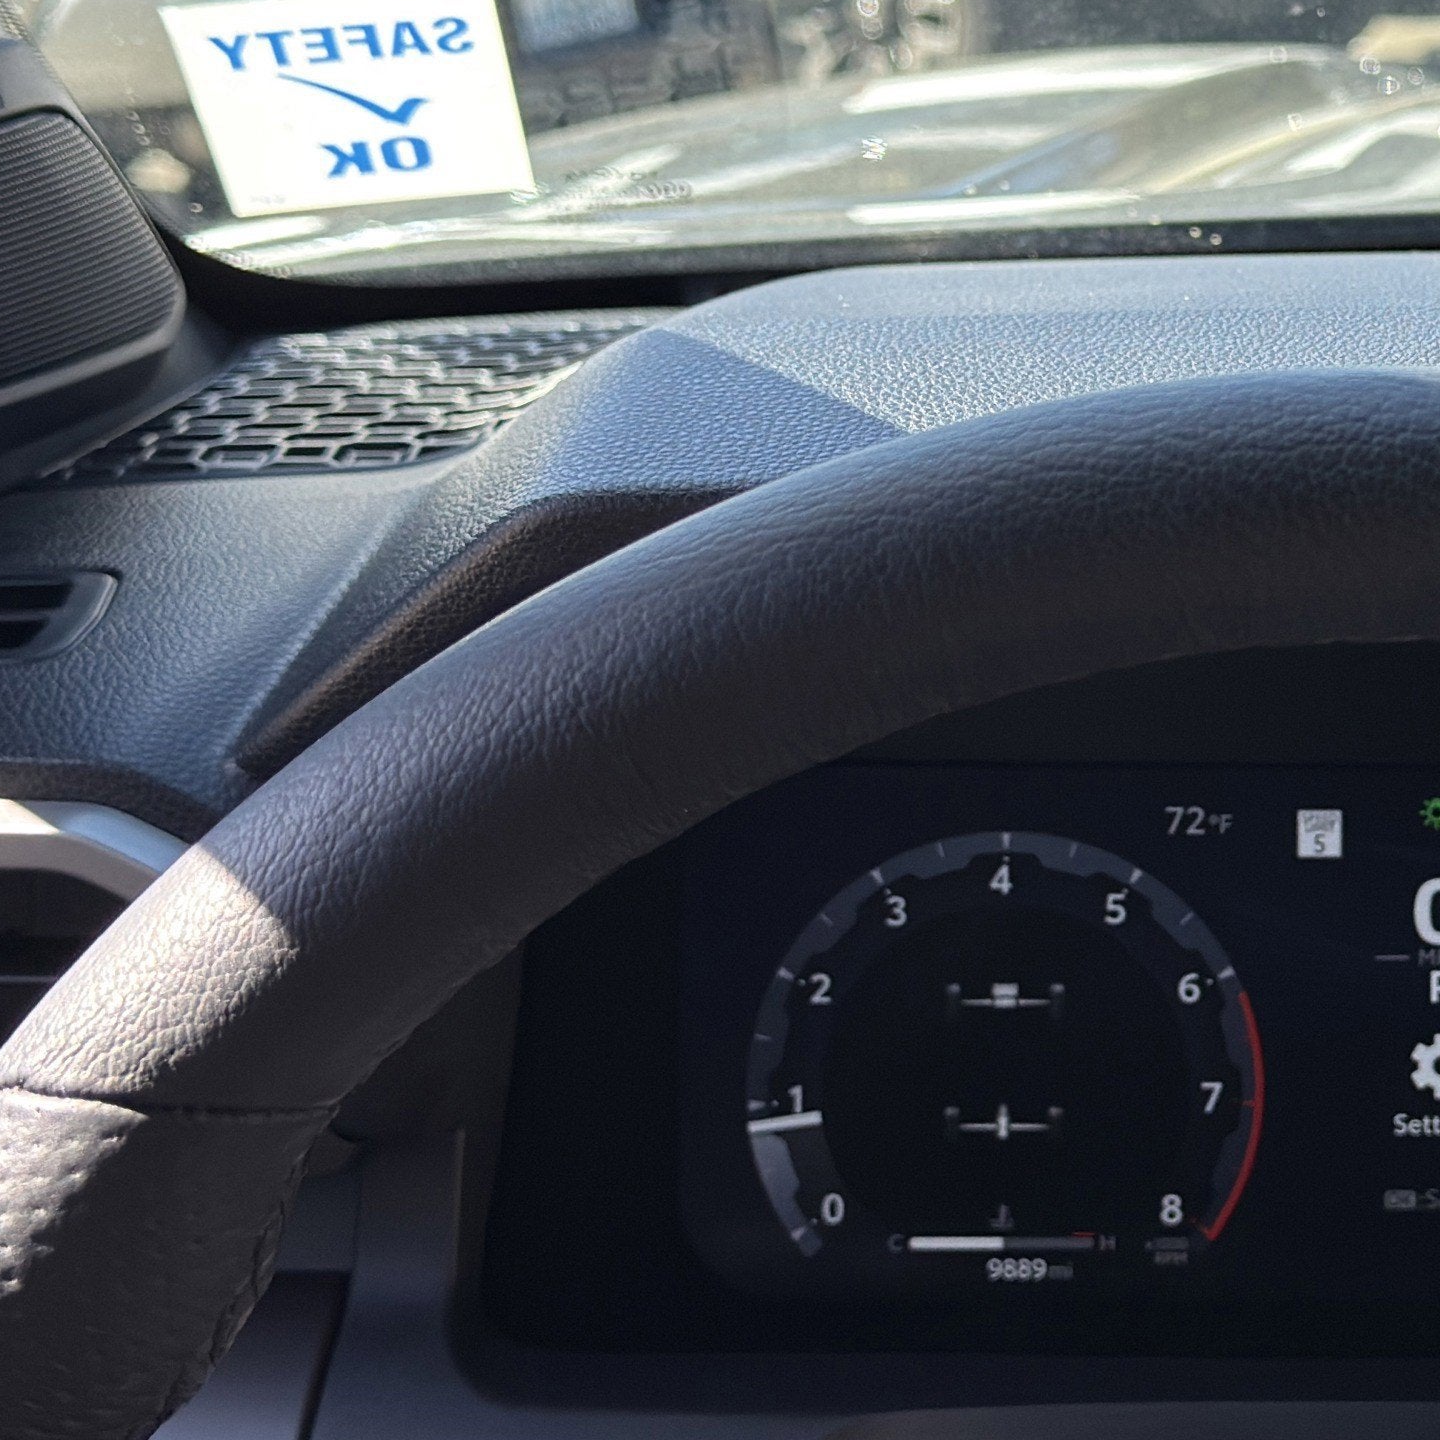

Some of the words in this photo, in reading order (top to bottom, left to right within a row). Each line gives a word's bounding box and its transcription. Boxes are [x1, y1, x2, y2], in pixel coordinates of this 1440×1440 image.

[990, 865, 1013, 895] 4
[885, 896, 907, 926] 3
[1104, 894, 1127, 925] 5
[810, 974, 832, 1004] 2
[1177, 974, 1201, 1003] 6
[788, 1085, 804, 1111] 1
[1200, 1083, 1222, 1113] 7
[821, 1194, 845, 1225] 0
[1160, 1194, 1182, 1224] 8
